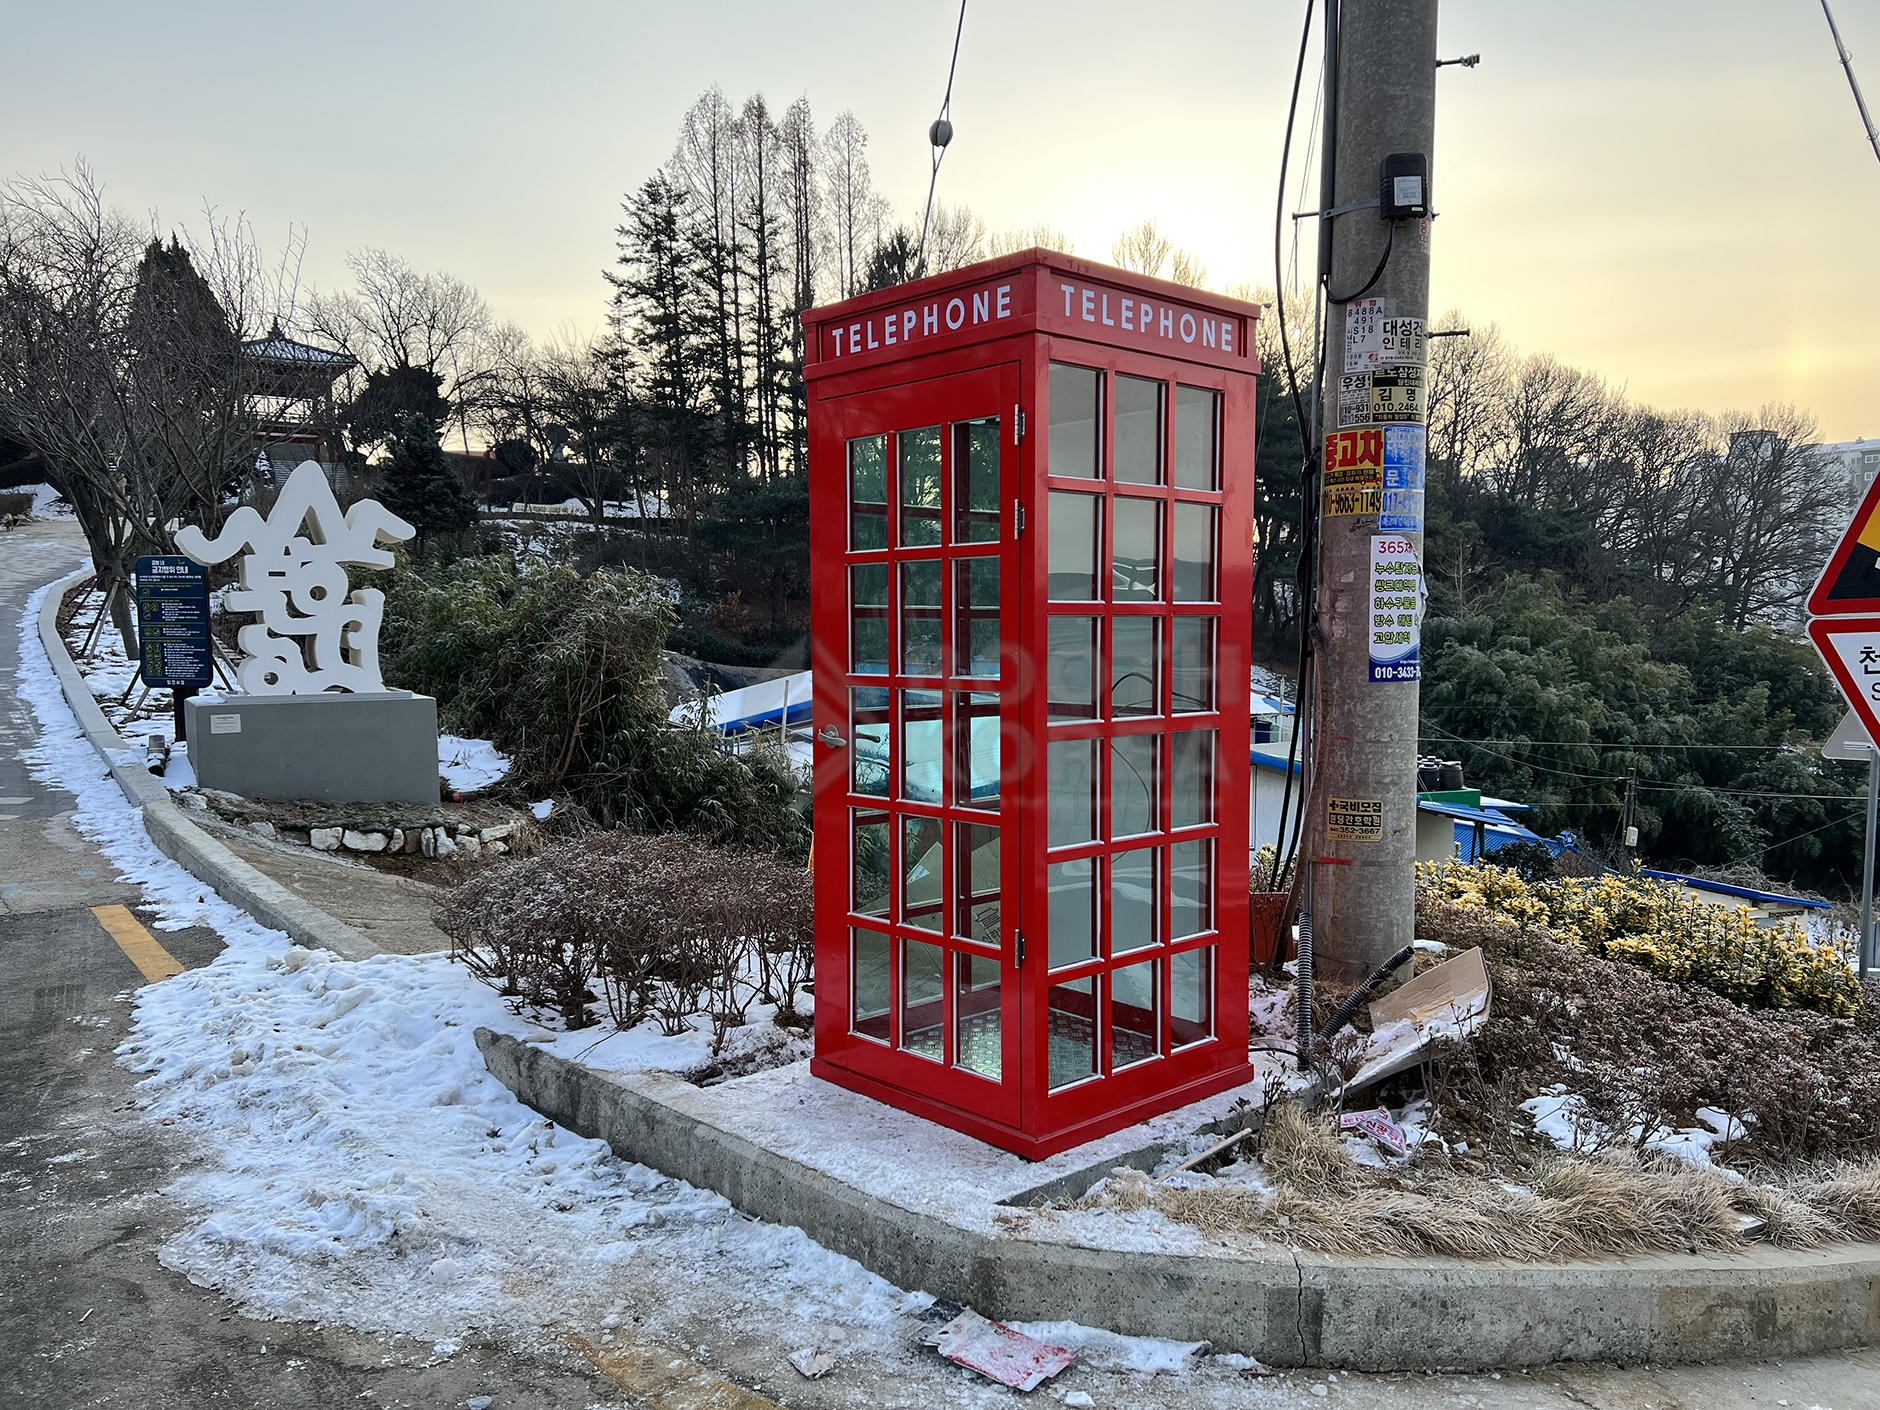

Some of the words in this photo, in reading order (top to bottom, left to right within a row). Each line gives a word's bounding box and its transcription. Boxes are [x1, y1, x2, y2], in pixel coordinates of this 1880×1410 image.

[1061, 284, 1232, 352] TELEPHONE
[1348, 307, 1383, 317] 8488A
[832, 285, 1012, 357] TELEPHONE
[1354, 317, 1374, 325] 491
[1353, 325, 1374, 335] S18
[1325, 430, 1383, 471] 중고차
[176, 566, 189, 574] 안내
[1374, 614, 1394, 627] 방수
[1373, 631, 1411, 645] 고압세척
[1339, 801, 1382, 813] 국비모집
[1339, 826, 1381, 835] 352-3667
